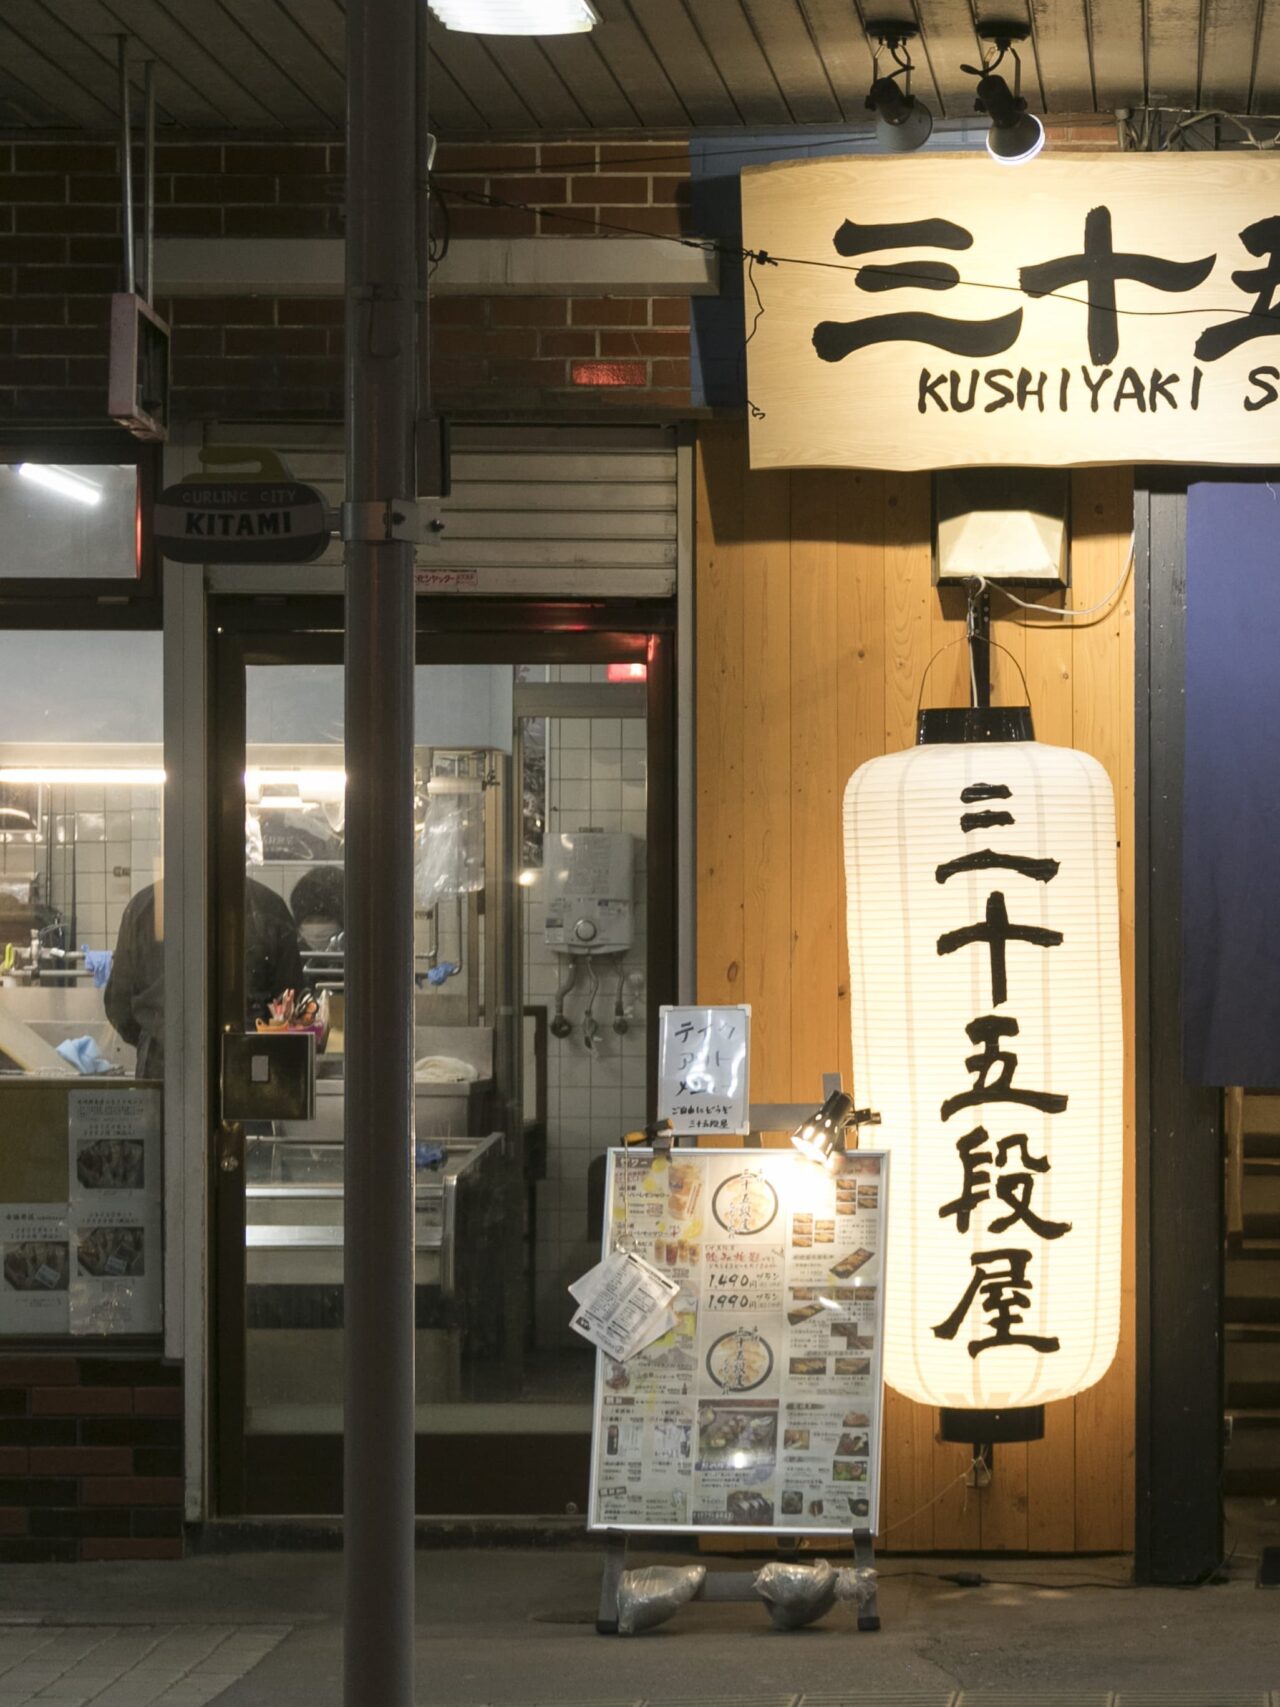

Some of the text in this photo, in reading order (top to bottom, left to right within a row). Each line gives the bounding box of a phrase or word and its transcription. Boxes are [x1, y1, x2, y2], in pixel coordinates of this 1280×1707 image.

[917, 364, 1204, 414] KUSHIYAKI
[260, 488, 297, 503] CITY
[184, 510, 292, 537] KITAMI
[930, 783, 1073, 1360] 三十五段屋
[671, 1104, 733, 1116] ご自由にどうぞ
